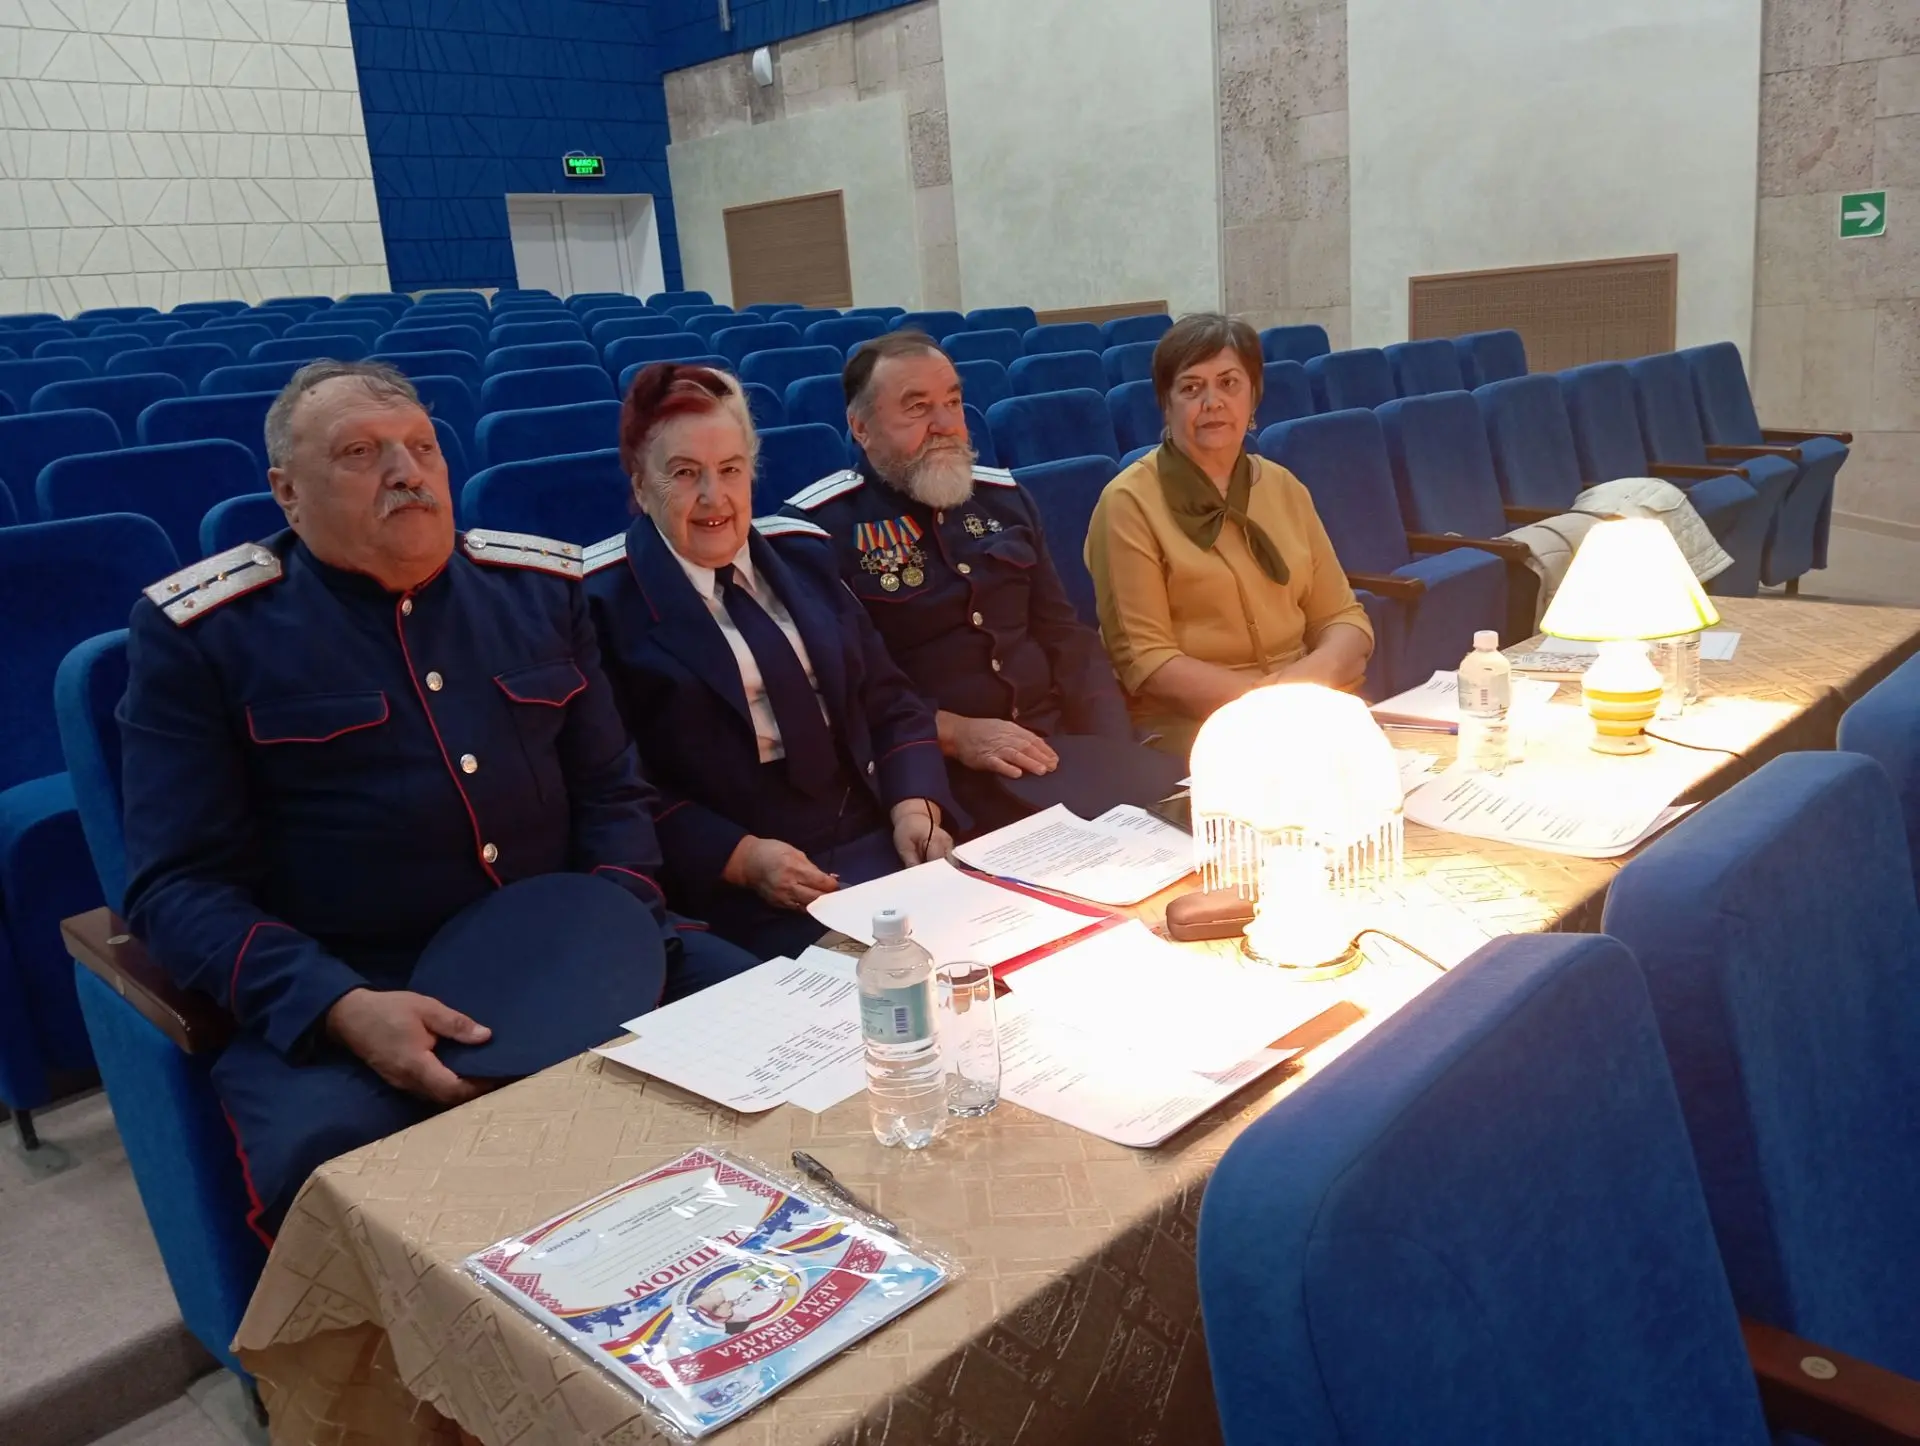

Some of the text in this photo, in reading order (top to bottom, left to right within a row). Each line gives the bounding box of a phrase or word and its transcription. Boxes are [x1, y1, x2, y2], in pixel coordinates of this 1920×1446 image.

[714, 1280, 839, 1358] ДЕДА ЕРМАКА
[811, 1294, 841, 1318] МЫ
[741, 1322, 805, 1360] ВНУКИ
